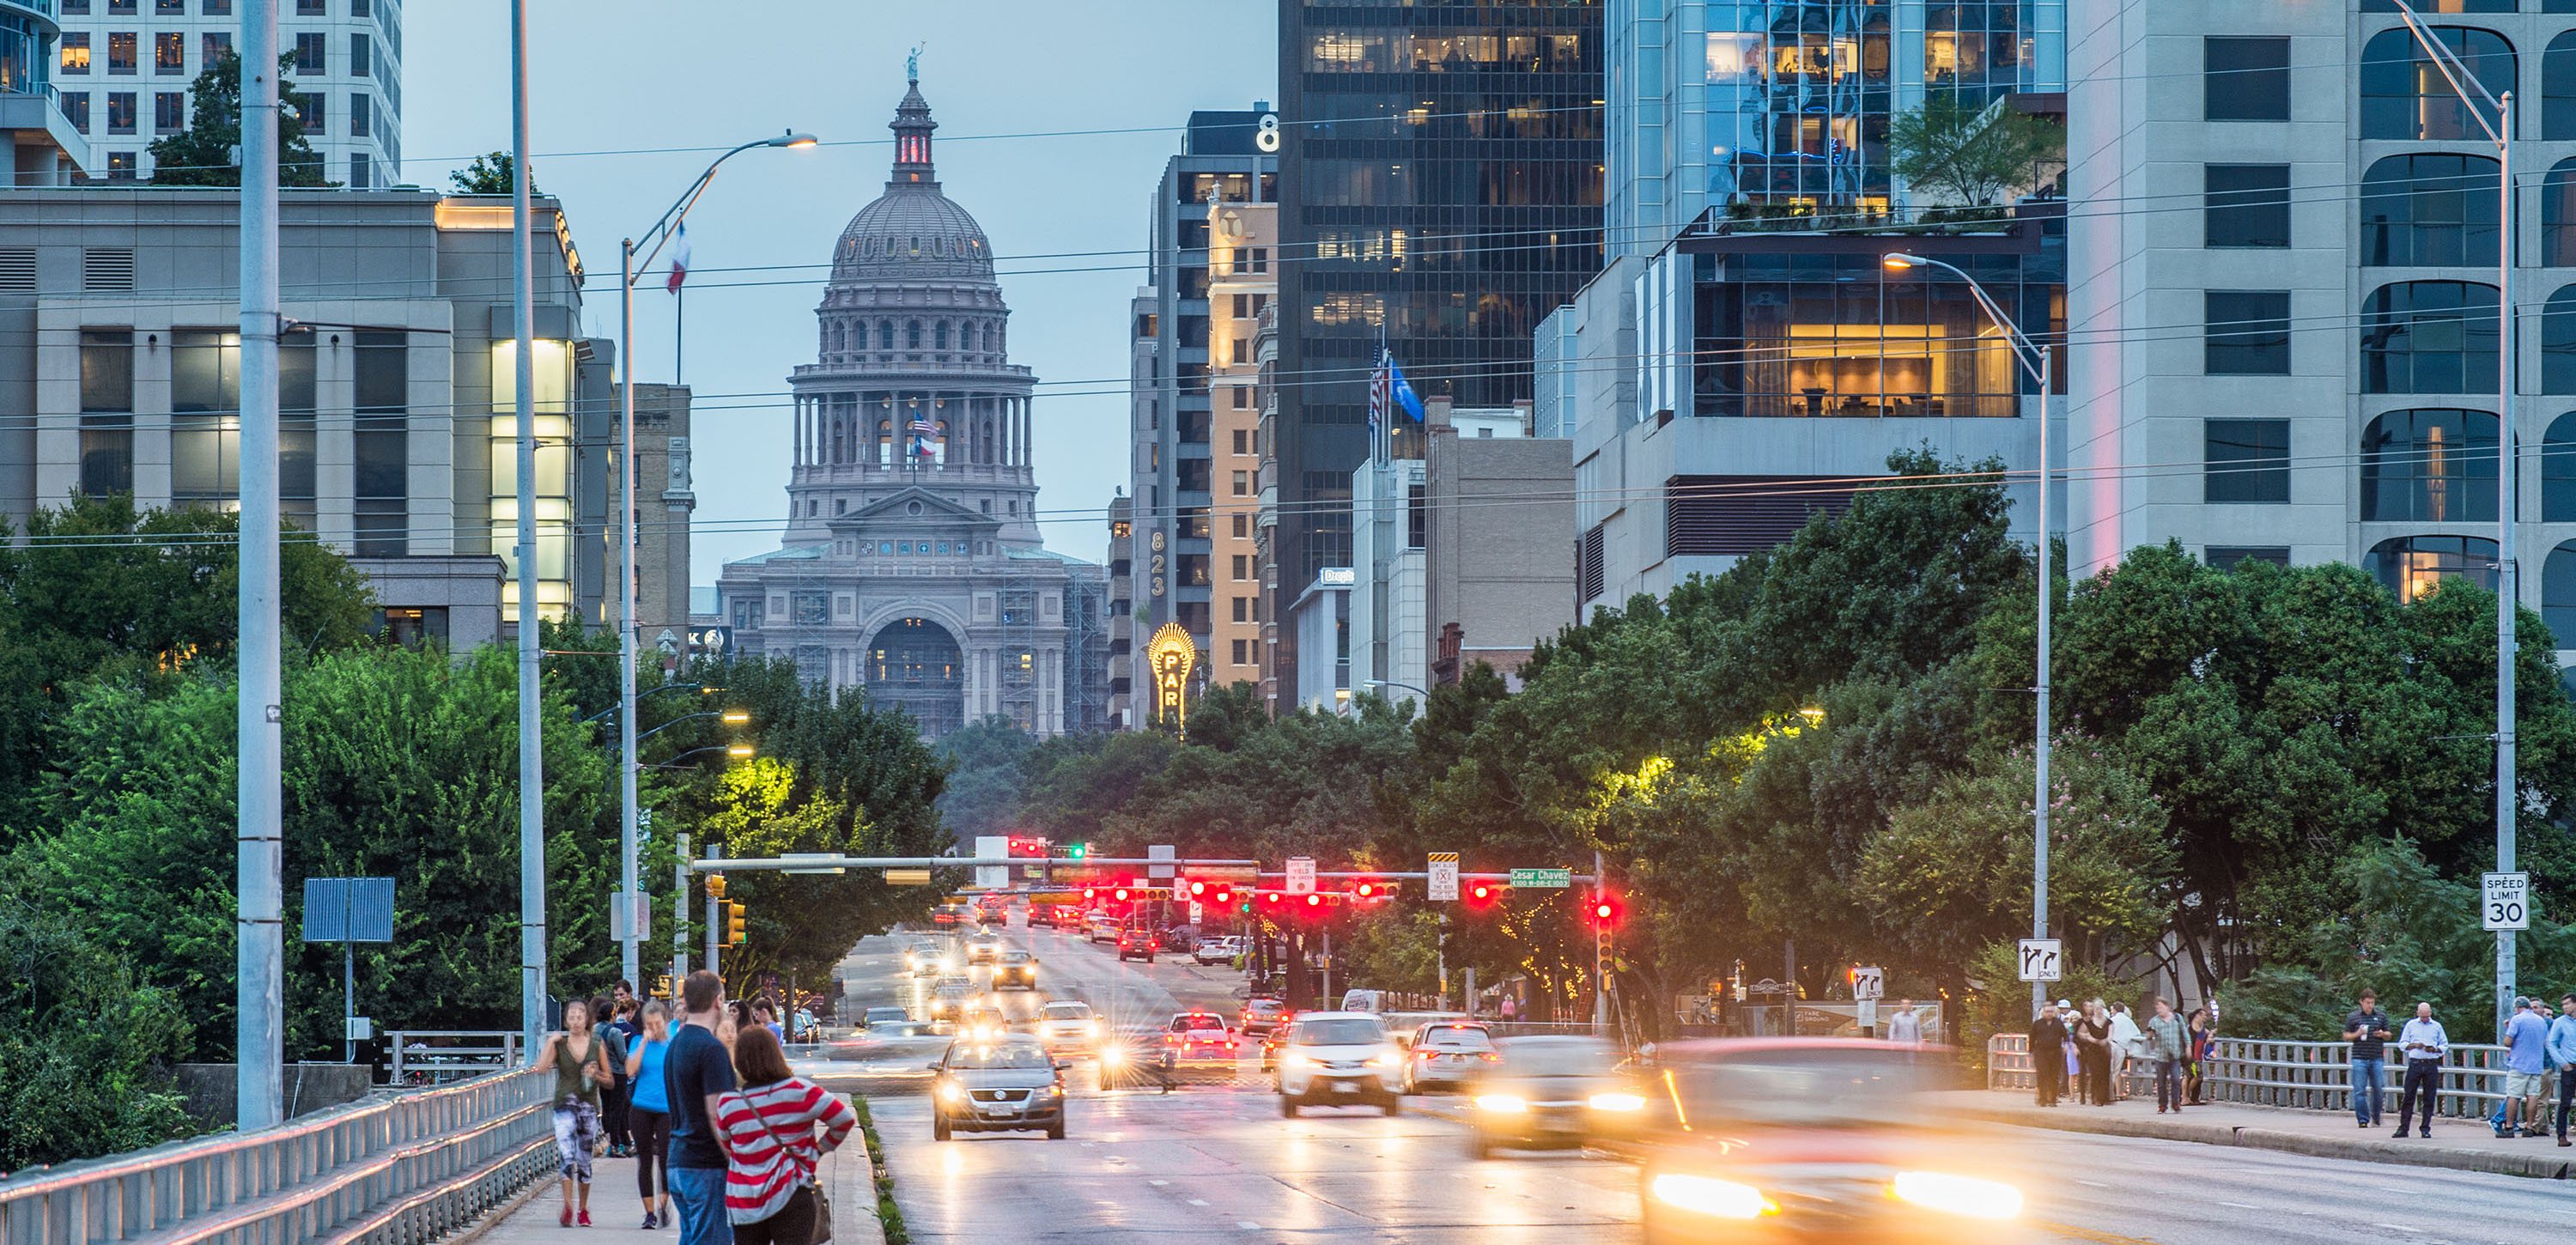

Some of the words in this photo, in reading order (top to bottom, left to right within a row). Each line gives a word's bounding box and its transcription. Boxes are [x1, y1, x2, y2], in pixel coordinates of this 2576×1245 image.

[1256, 114, 1279, 152] 8
[1151, 532, 1164, 596] 823
[1164, 655, 1178, 707] PAR
[1512, 870, 1535, 880] Cesar
[1538, 870, 1568, 880] Chavez
[2487, 879, 2524, 889] SPEED
[2491, 891, 2519, 900] LIMIT
[2490, 902, 2523, 922] 30
